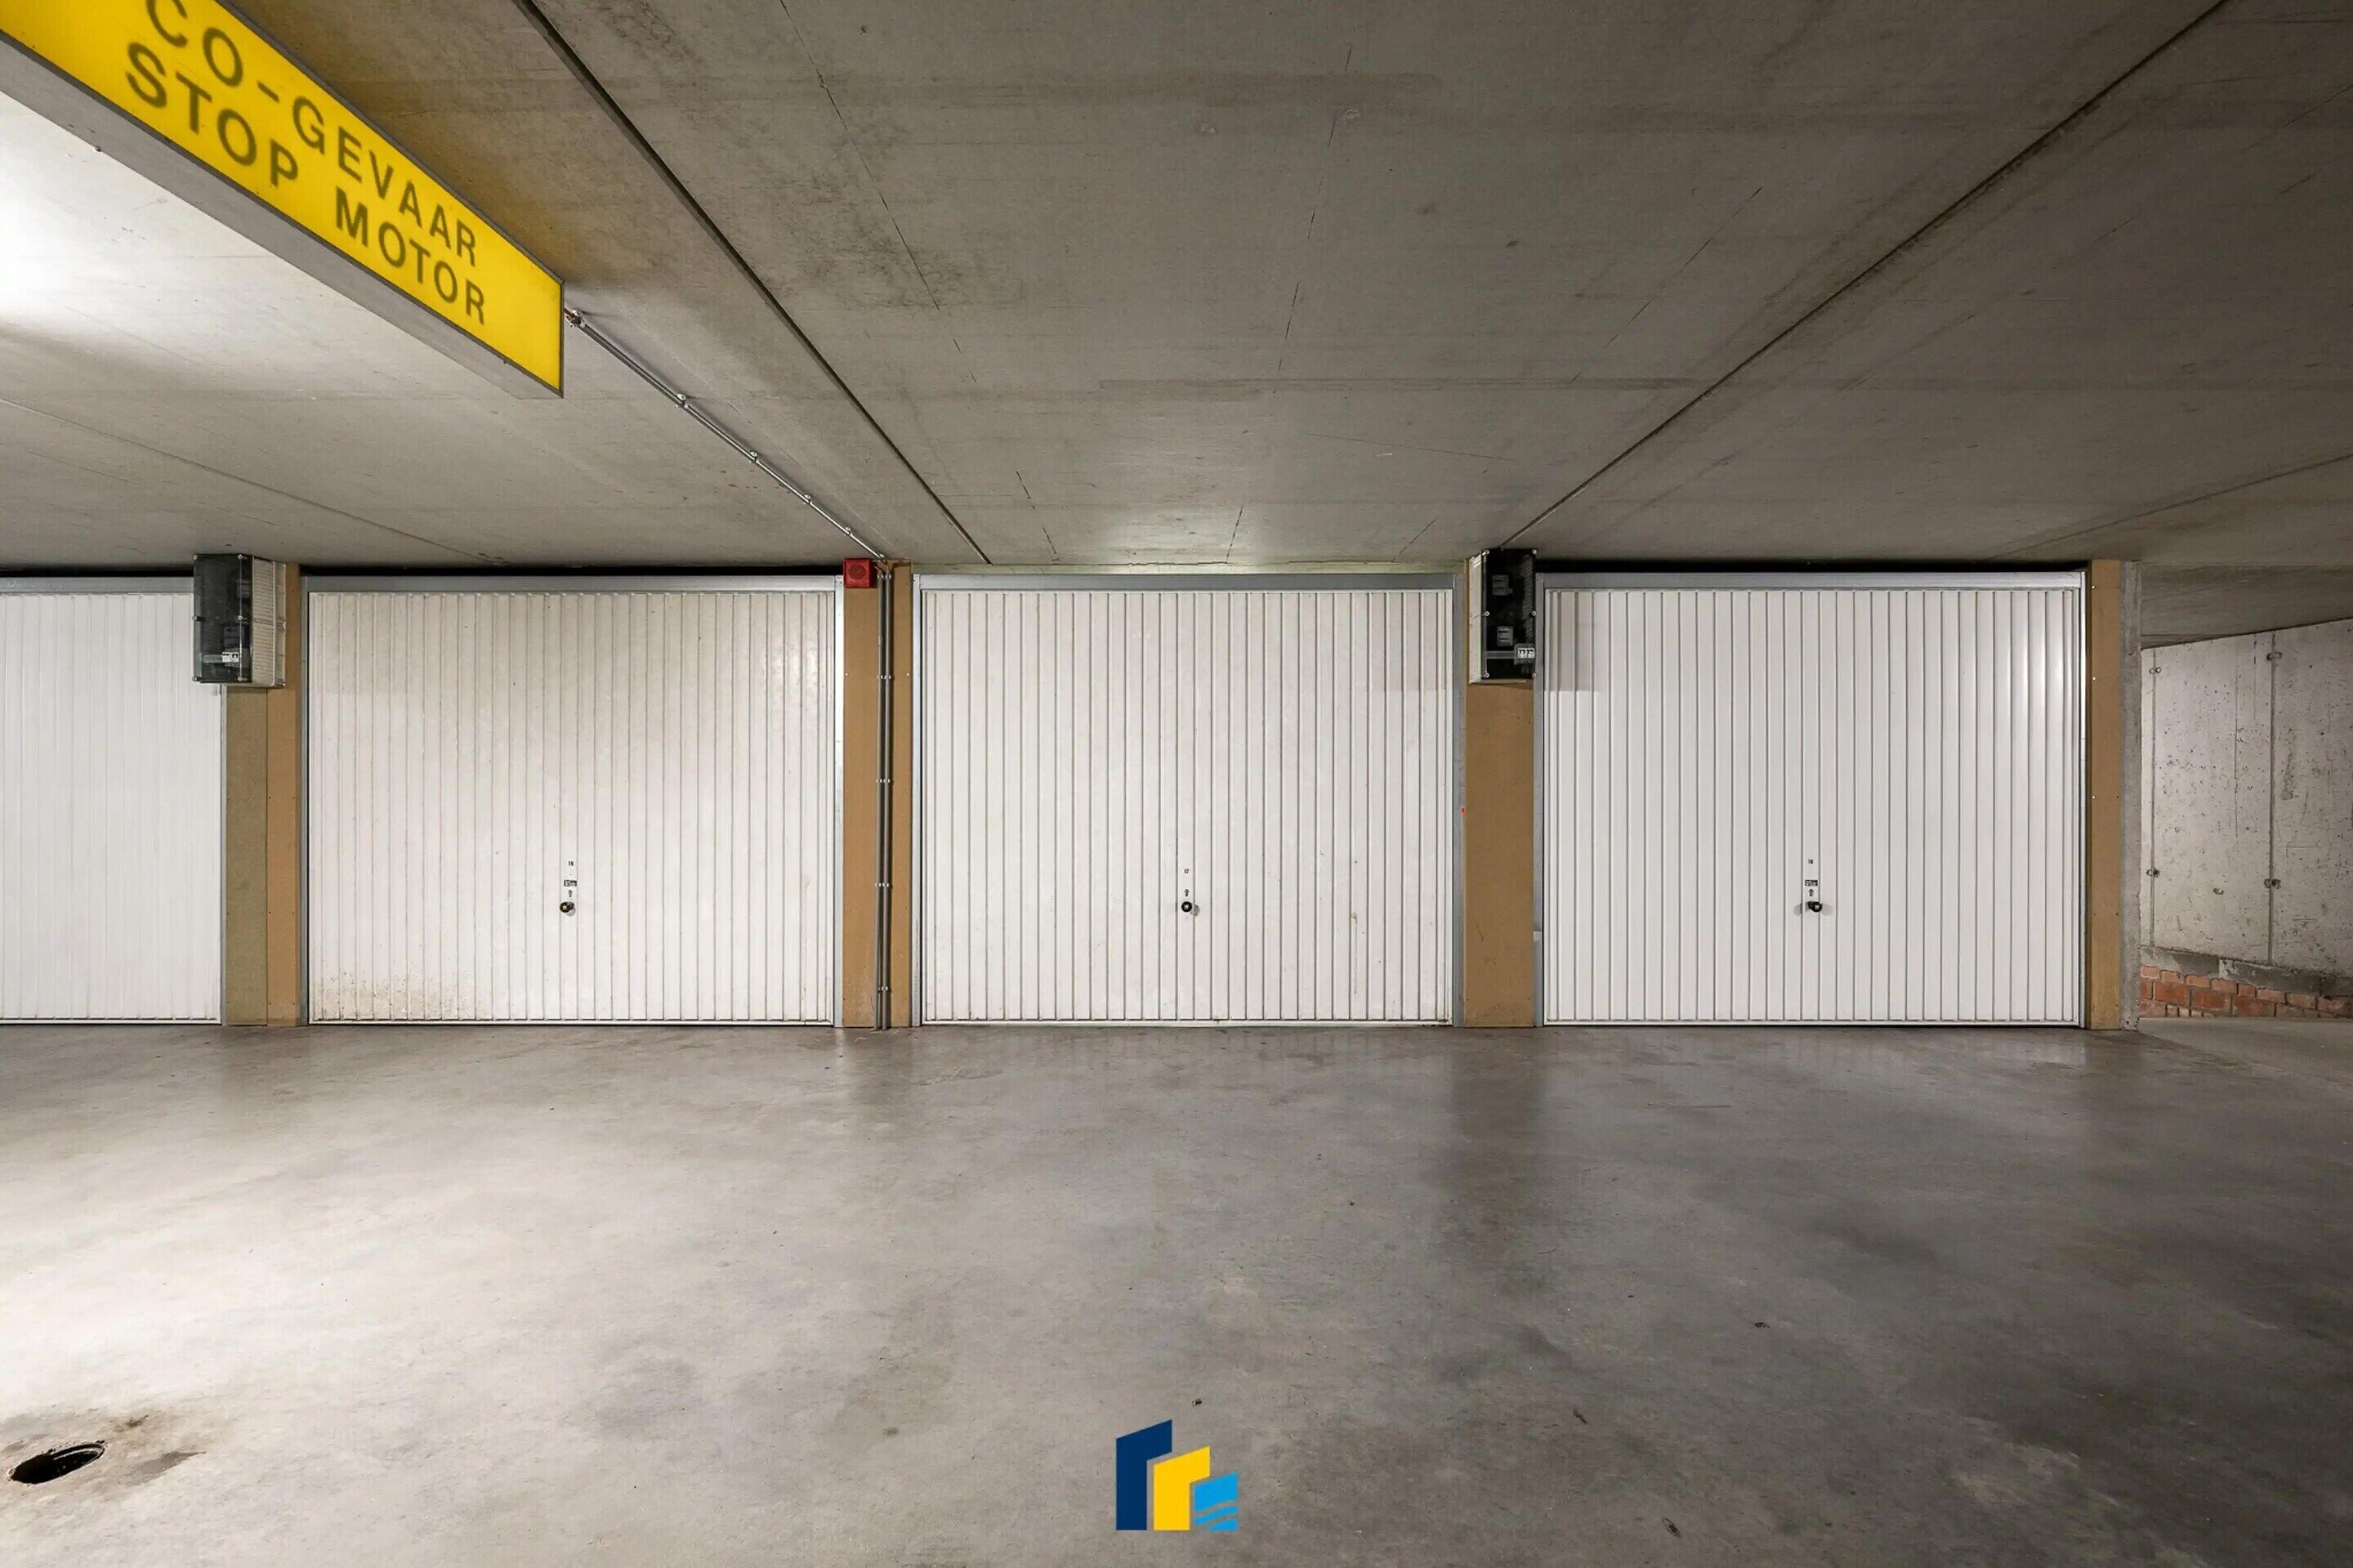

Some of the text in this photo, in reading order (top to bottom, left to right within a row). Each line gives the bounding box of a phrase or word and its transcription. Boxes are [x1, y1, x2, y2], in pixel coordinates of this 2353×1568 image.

[126, 42, 485, 326] STOP MOTOR
[145, 0, 477, 268] CO-GEVAAR
